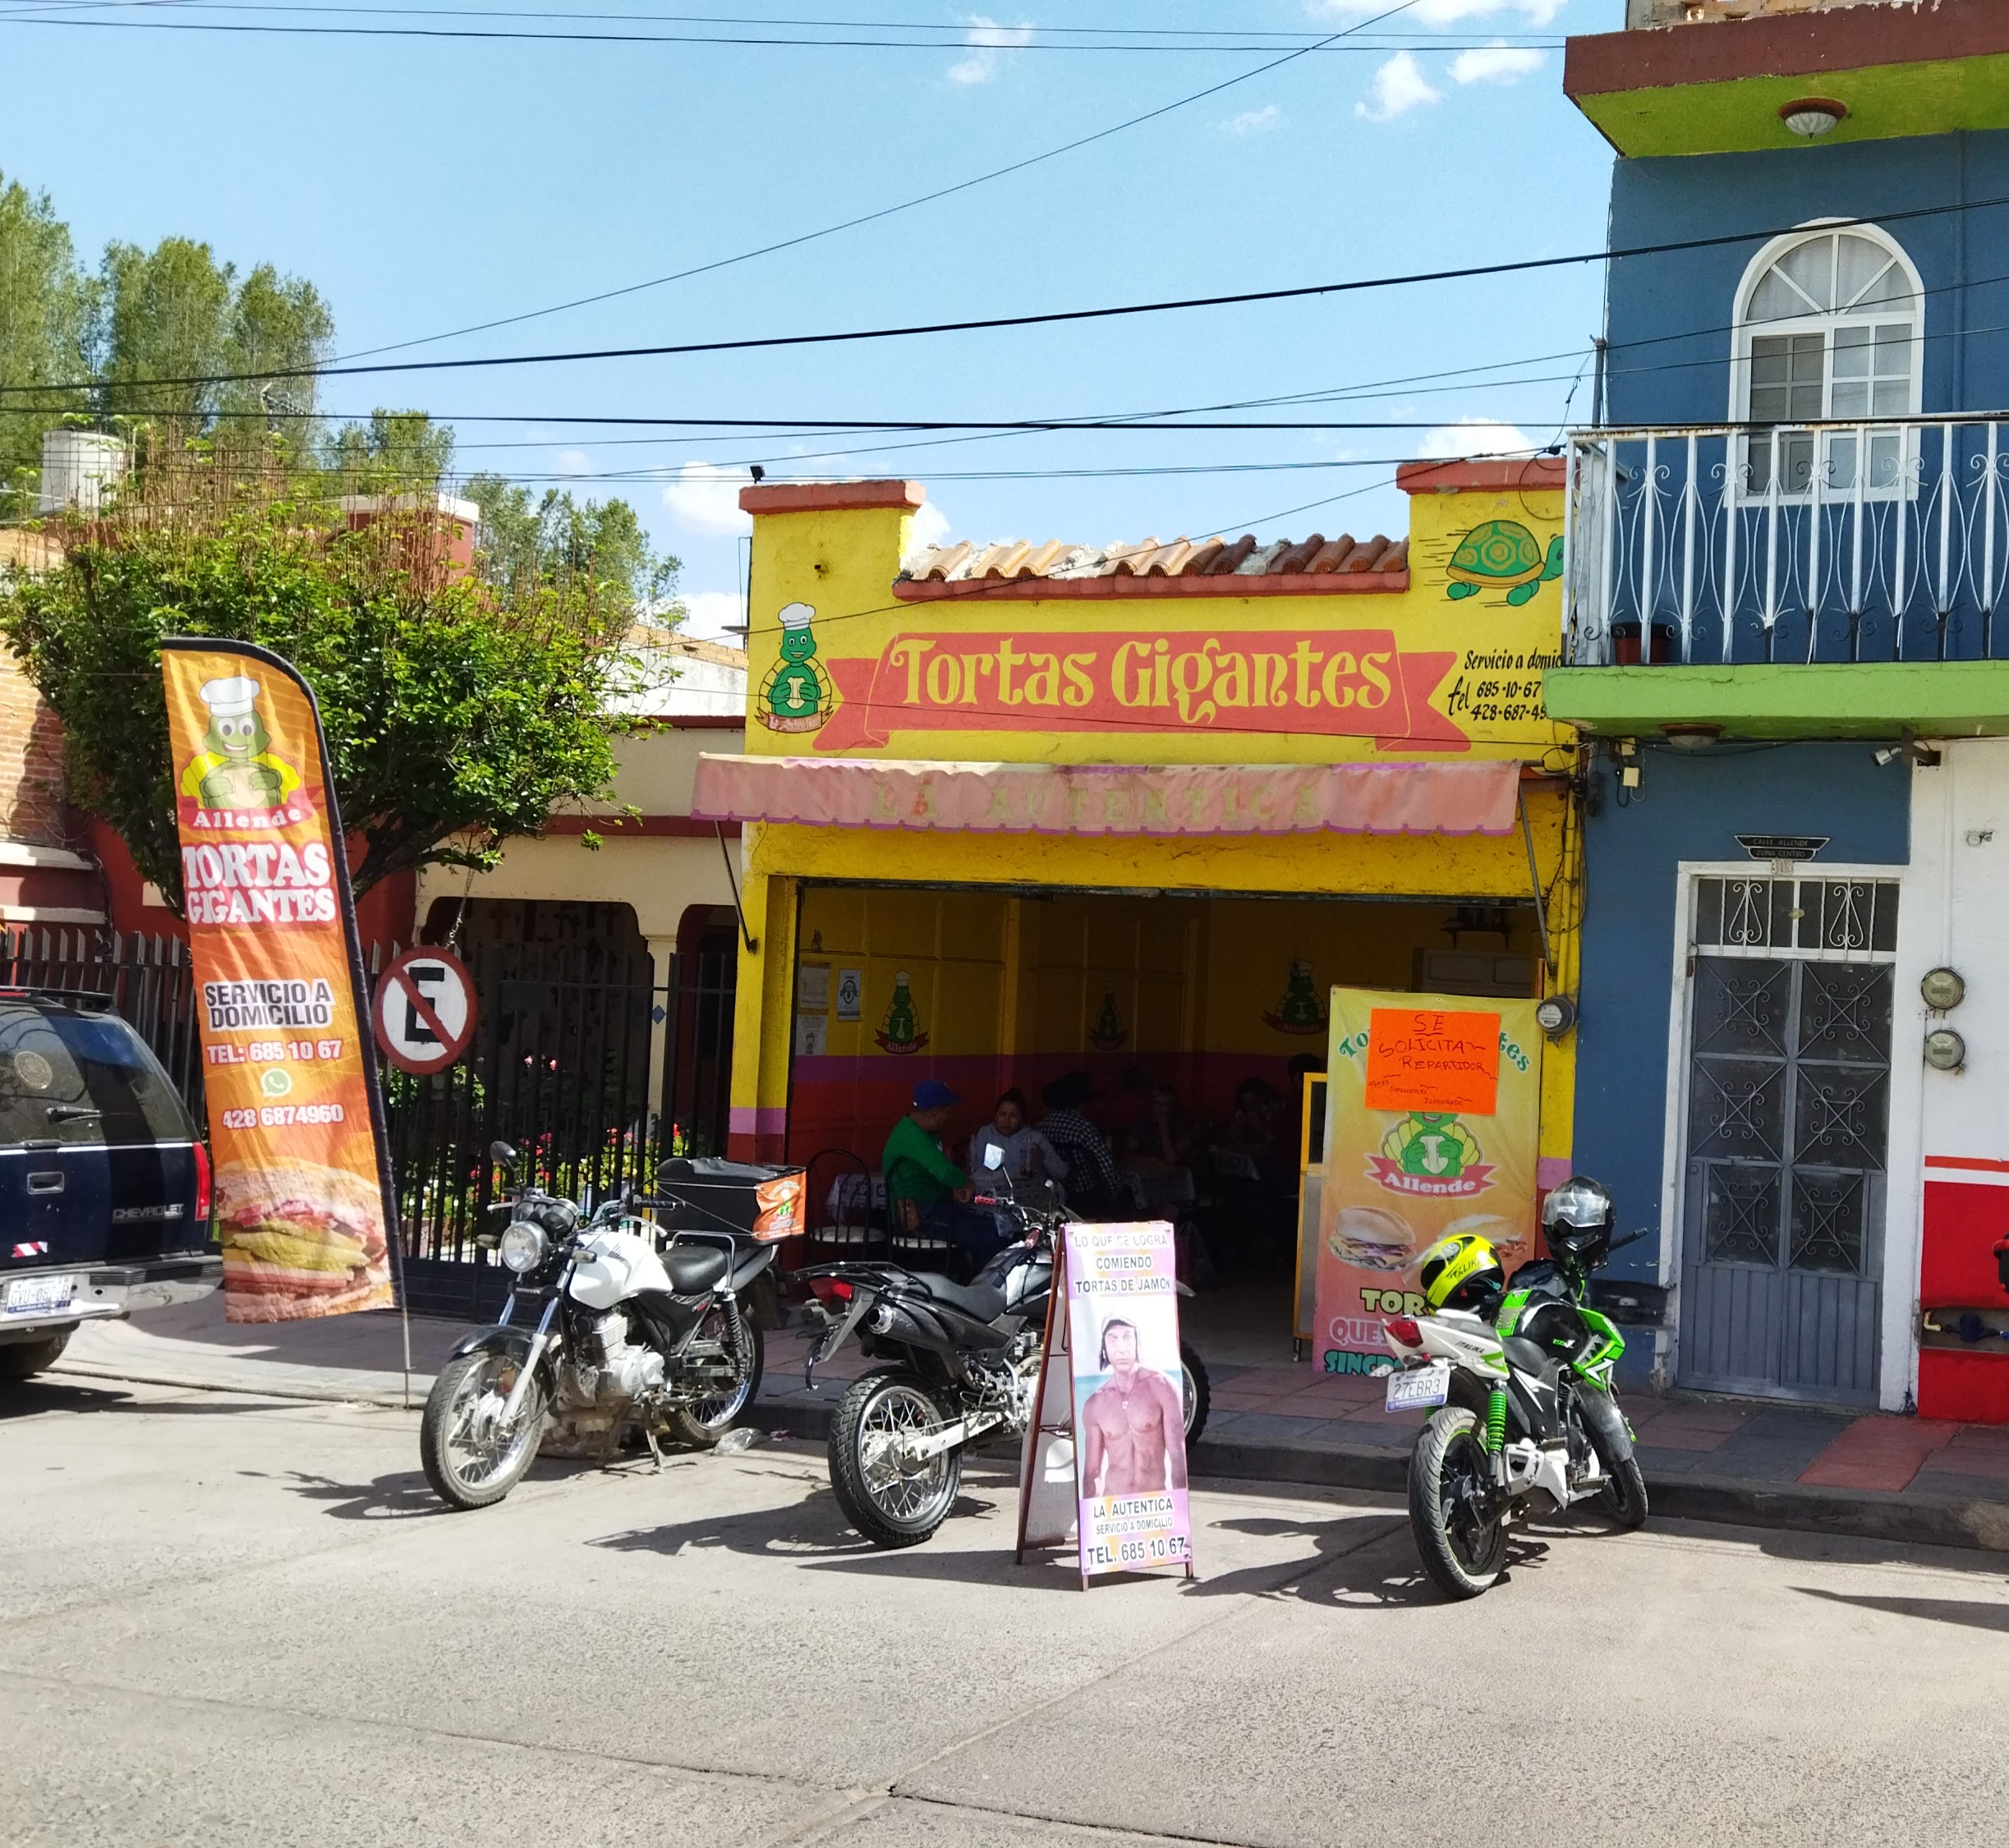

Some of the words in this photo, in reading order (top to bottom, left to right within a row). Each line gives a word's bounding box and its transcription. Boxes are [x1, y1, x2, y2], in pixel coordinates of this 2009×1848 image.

[1464, 649, 1513, 670] Servicio
[1515, 655, 1524, 669] a
[890, 637, 1096, 706] Tortas
[1111, 638, 1391, 725] Gigantes
[1448, 675, 1470, 716] tel
[876, 784, 937, 817] LA
[987, 786, 1321, 822] AUTENTICA
[193, 808, 301, 827] Allende
[1778, 850, 1806, 858] CENTRO
[182, 844, 330, 888] TORTAS
[188, 888, 336, 924] GIGANTES
[205, 982, 306, 1007] SERVICIO
[315, 981, 330, 1003] A
[405, 967, 445, 1042] E
[211, 1004, 329, 1028] DOMICILIO
[1414, 1014, 1444, 1032] SE
[207, 1044, 245, 1064] TEL:
[250, 1041, 285, 1061] 685
[288, 1041, 314, 1060] 10
[318, 1039, 342, 1060] 67
[1340, 1028, 1370, 1058] To
[1379, 1038, 1464, 1058] SOLICITA
[1399, 1055, 1484, 1072] REPARTIDOR
[223, 1109, 257, 1129] 428
[260, 1104, 344, 1126] 6874960
[1384, 1173, 1476, 1193] Allende
[113, 1203, 184, 1219] CHEVROLET
[1074, 1236, 1088, 1248] LO
[1117, 1235, 1129, 1246] SE
[1133, 1234, 1167, 1246] LOGRA
[1096, 1256, 1152, 1269] COMIENDO
[1076, 1280, 1118, 1293] TORTAS
[1121, 1279, 1134, 1291] DE
[1138, 1276, 1170, 1290] JAMÓN
[1455, 1340, 1485, 1354] ITALIKA
[1394, 1378, 1441, 1400] 27EBR3
[1093, 1505, 1106, 1518] LA
[1112, 1497, 1173, 1516] AUTENTICA
[1096, 1521, 1129, 1535] SERVICIO
[1130, 1520, 1135, 1531] A
[1137, 1516, 1173, 1531] DOMICILIO
[1087, 1546, 1117, 1565] TEL.
[1121, 1542, 1145, 1561] 685
[1150, 1539, 1165, 1557] 10
[1169, 1537, 1185, 1555] 67
